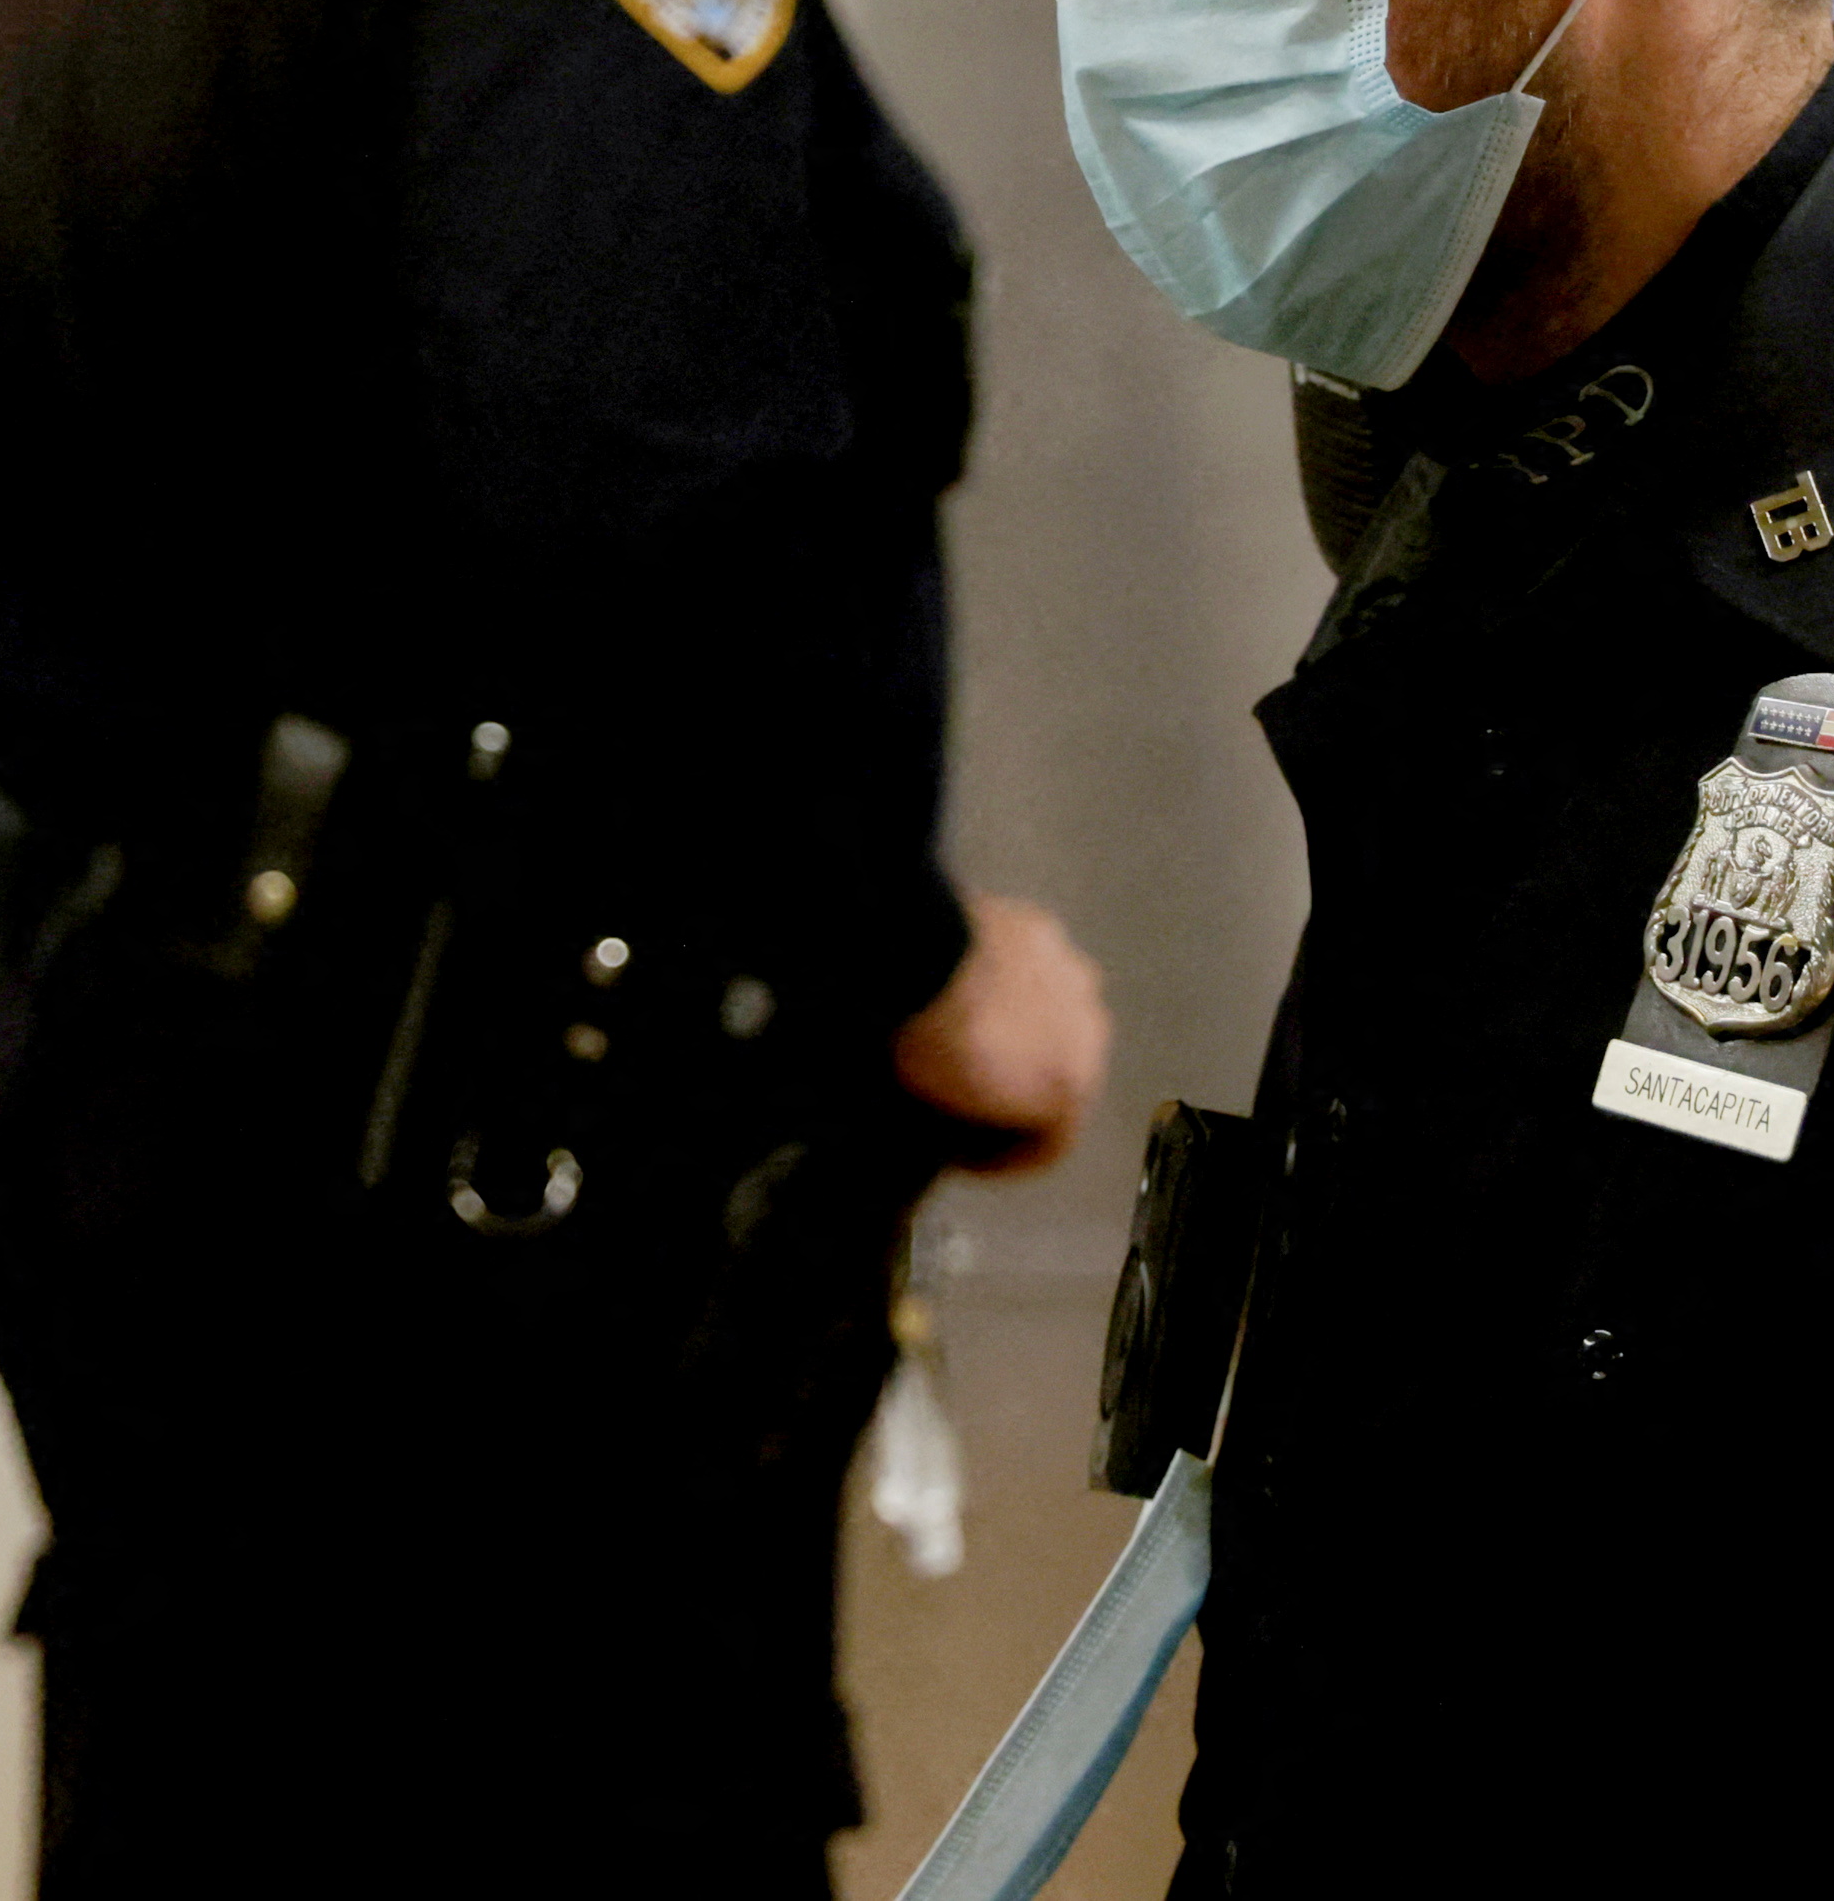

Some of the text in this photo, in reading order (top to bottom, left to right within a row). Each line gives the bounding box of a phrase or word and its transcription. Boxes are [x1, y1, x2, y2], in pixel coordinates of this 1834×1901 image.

[1710, 788, 1748, 813] CITY
[1749, 785, 1769, 804] OF
[1769, 785, 1804, 809] NEW
[1732, 806, 1804, 845] POLICE
[1655, 905, 1799, 1012] 31956
[1624, 1065, 1772, 1134] SANTACAPITA
